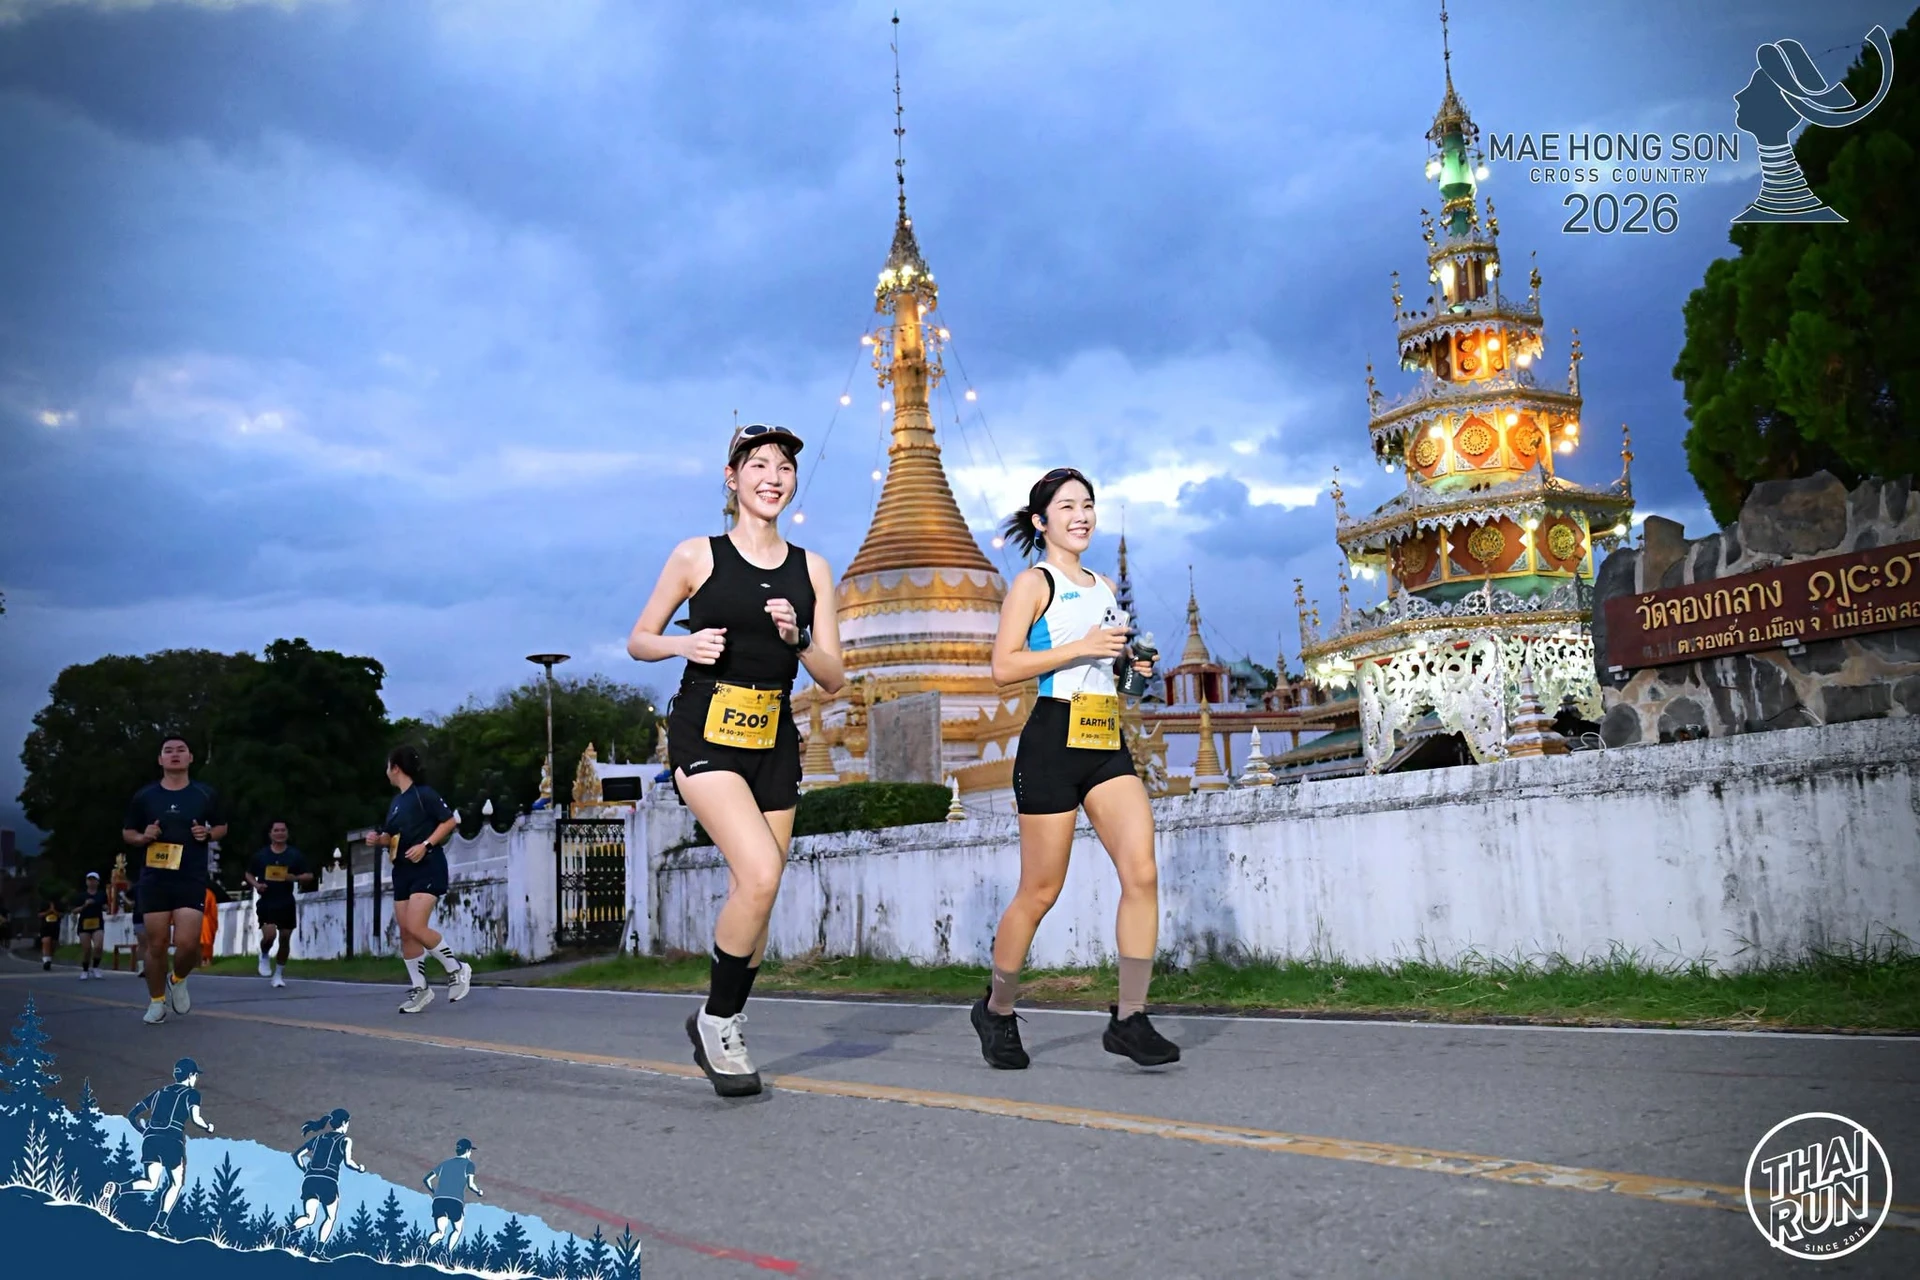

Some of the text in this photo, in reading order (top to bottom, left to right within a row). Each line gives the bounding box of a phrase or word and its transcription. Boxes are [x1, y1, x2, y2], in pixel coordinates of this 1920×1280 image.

[1060, 591, 1080, 602] HOKA
[1636, 579, 1783, 630] วัดจองกลาง
[722, 708, 769, 729] F209
[1080, 717, 1106, 727] EARTH
